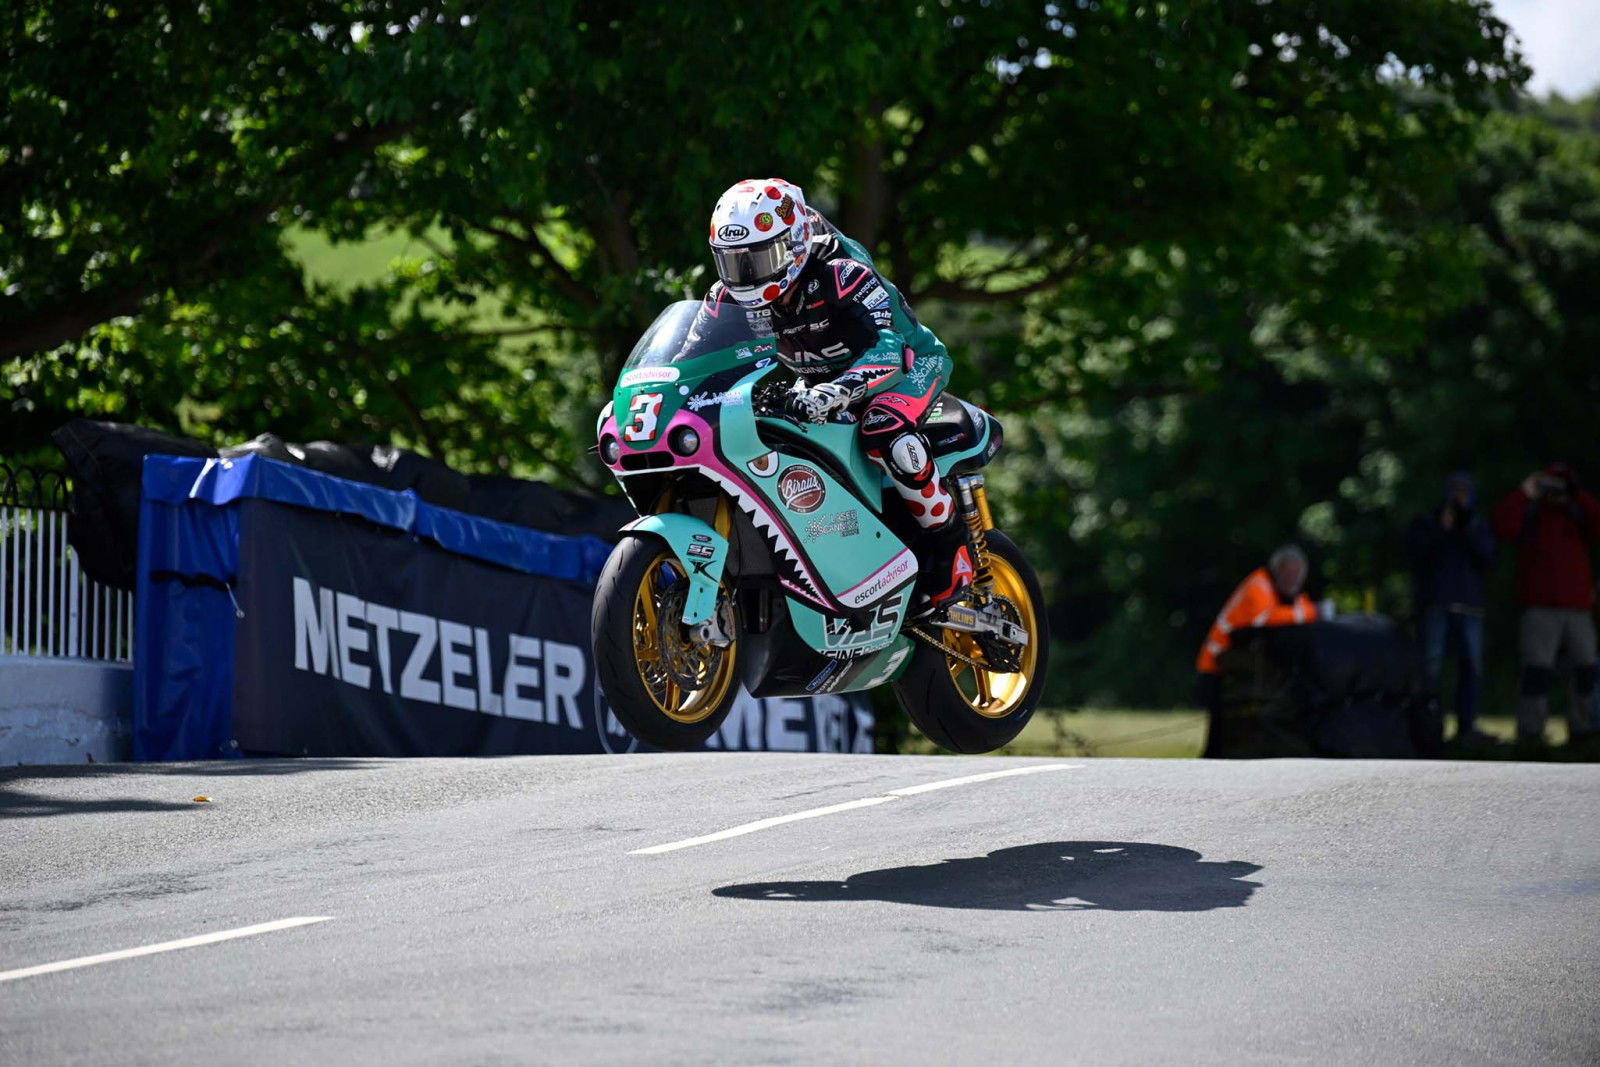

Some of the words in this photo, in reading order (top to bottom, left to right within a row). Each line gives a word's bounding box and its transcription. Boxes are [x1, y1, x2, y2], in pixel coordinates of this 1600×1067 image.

[722, 226, 747, 238] Arai
[624, 393, 664, 443] 3
[689, 544, 714, 555] SC
[854, 560, 909, 604] escortadvisor
[293, 576, 584, 730] METZELER
